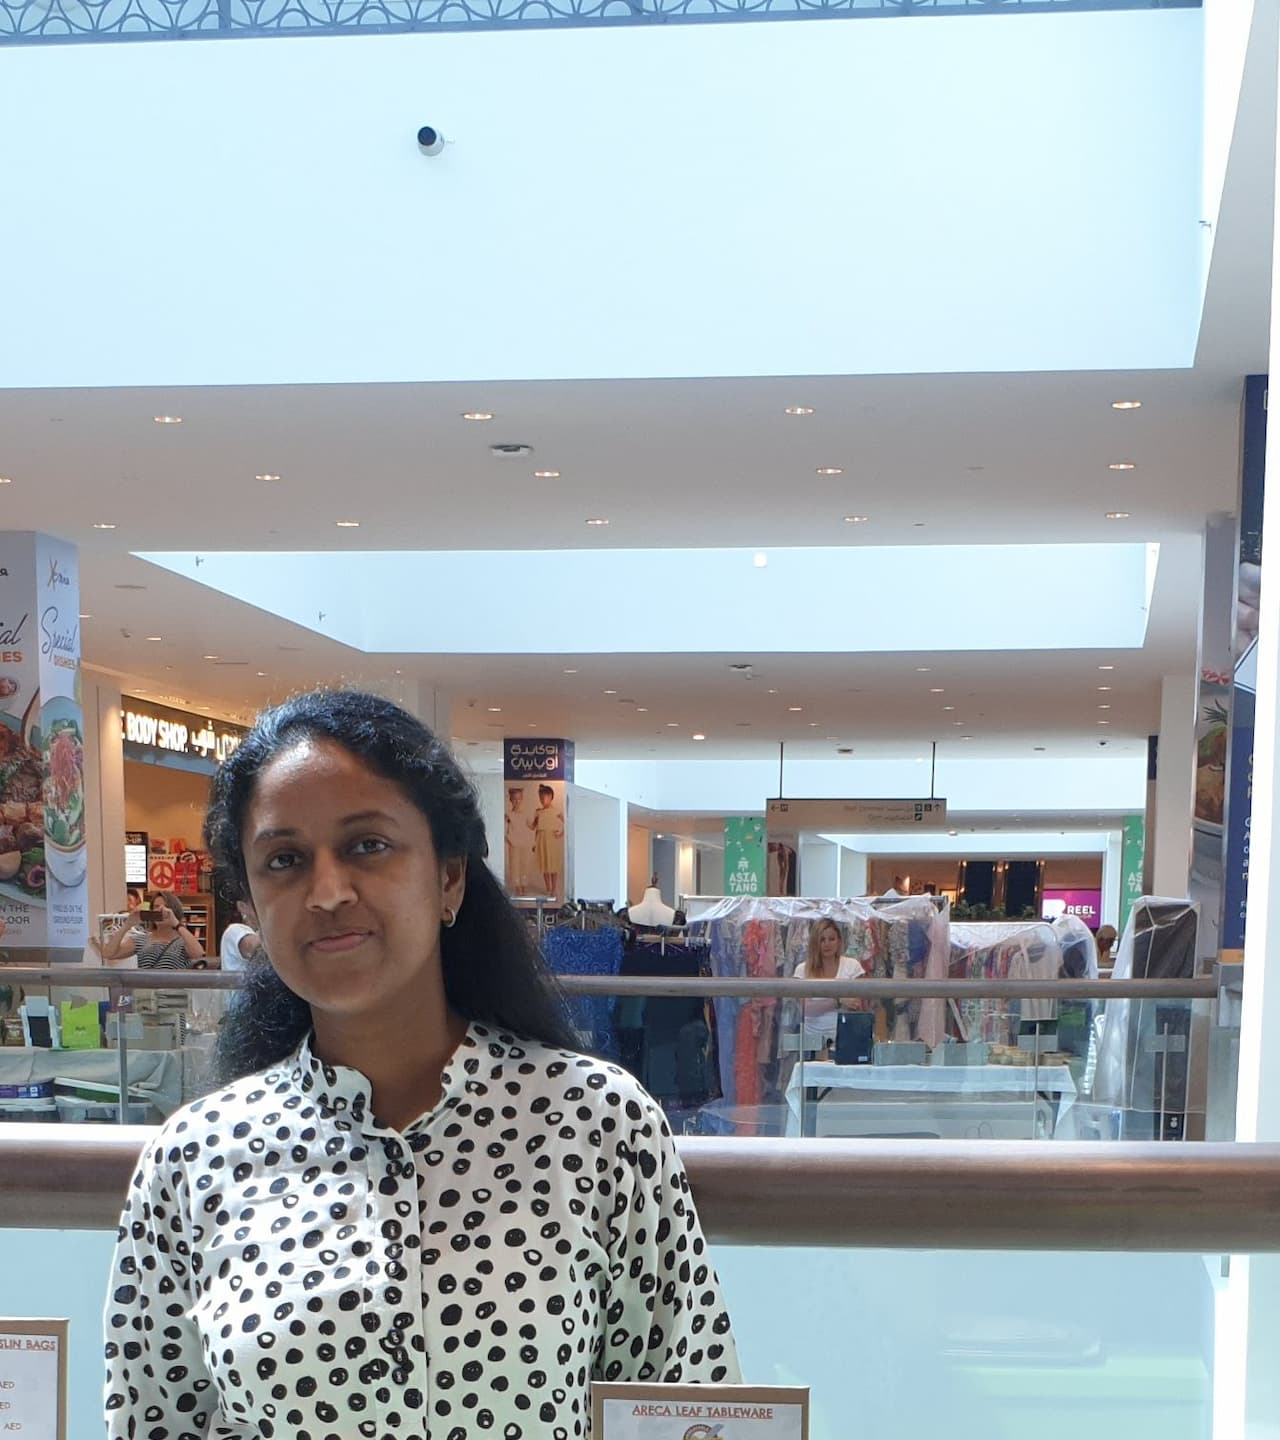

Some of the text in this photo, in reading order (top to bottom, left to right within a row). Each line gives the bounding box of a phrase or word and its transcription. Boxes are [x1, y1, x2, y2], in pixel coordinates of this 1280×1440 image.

[41, 606, 78, 662] Special
[126, 712, 188, 752] BODY SHOP.
[729, 873, 757, 882] ASIA
[729, 883, 757, 892] TANG
[10, 904, 29, 912] THE
[1067, 906, 1096, 914] REEL
[26, 1340, 56, 1351] BAGS
[632, 1405, 773, 1419] ARECA LEAF TABLEWARE
